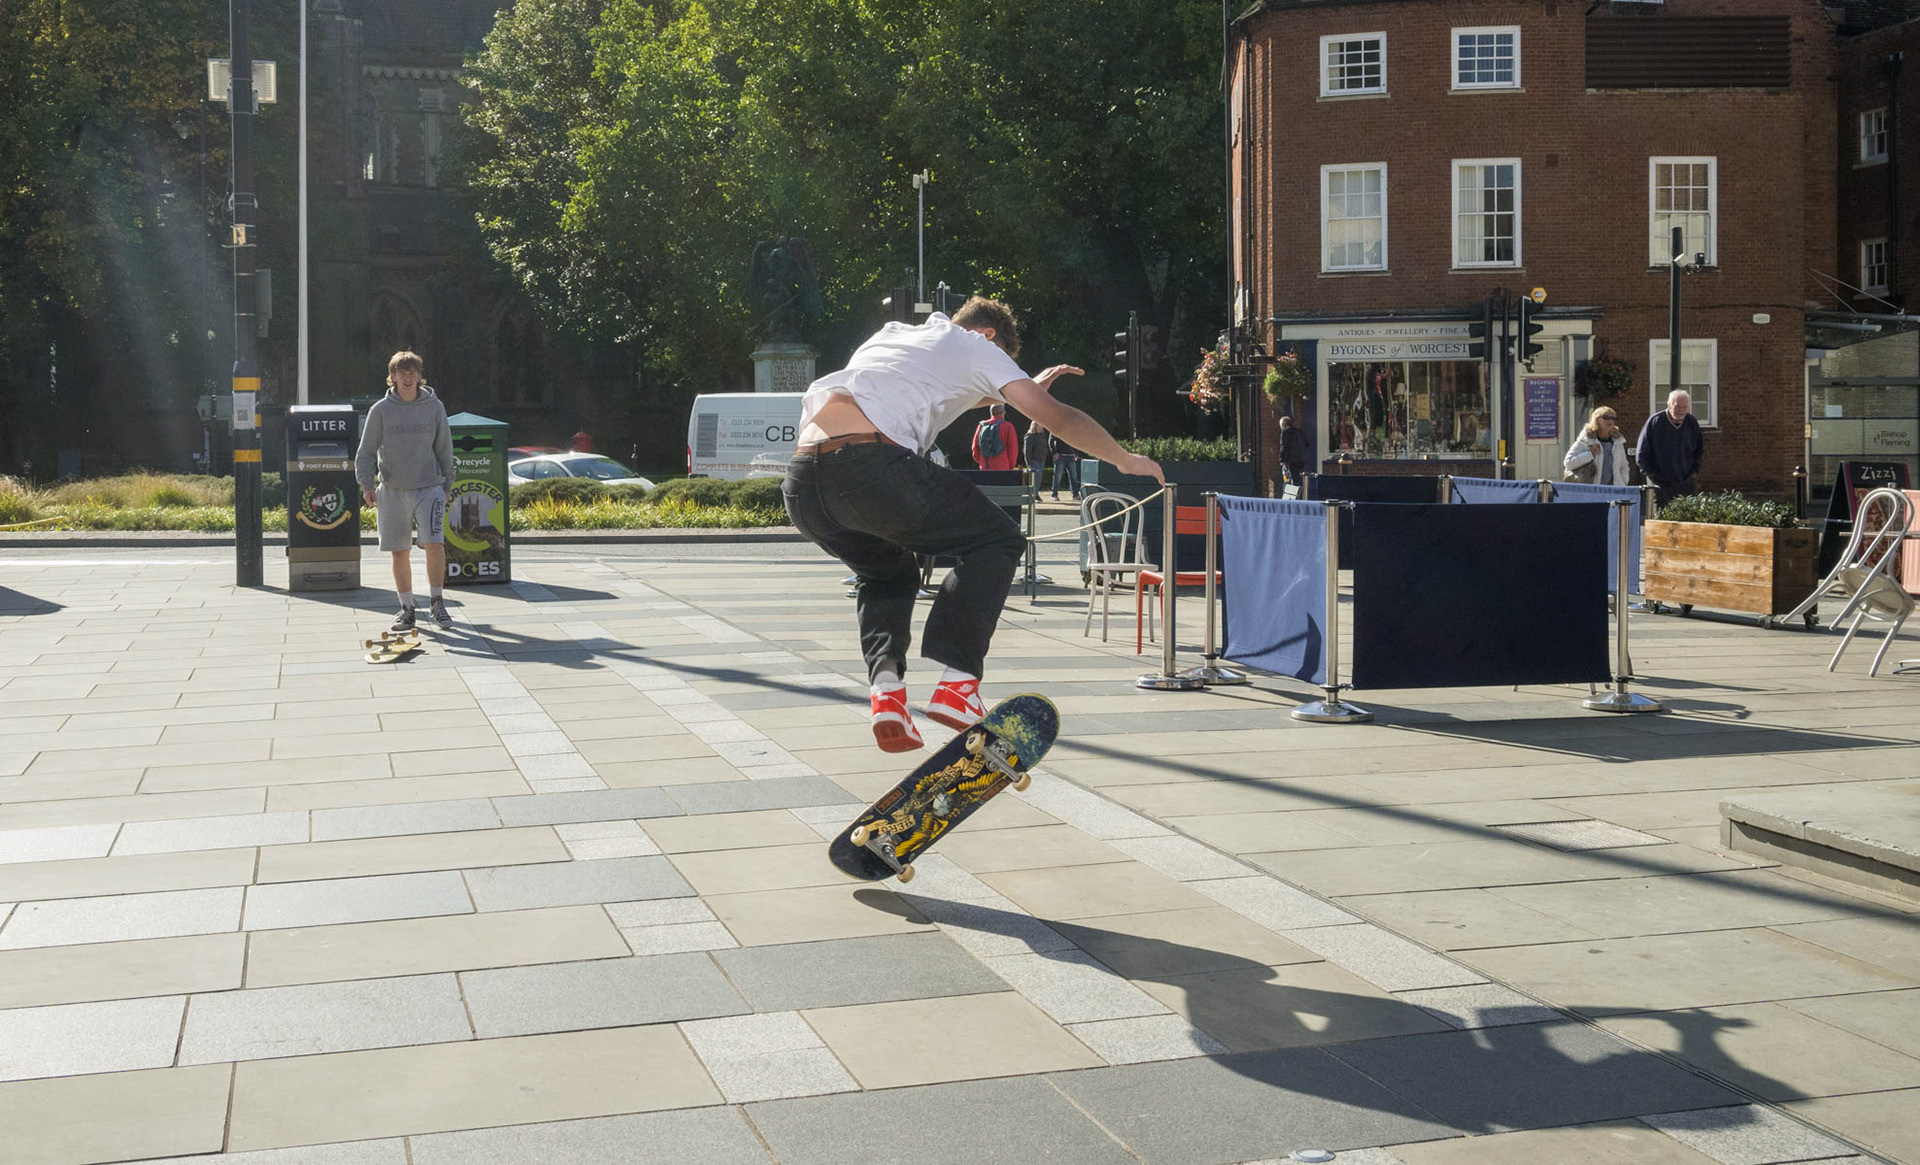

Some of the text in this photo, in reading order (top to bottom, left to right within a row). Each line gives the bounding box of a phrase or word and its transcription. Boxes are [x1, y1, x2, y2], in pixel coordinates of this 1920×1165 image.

[1384, 328, 1429, 336] JEWELLERY
[1440, 327, 1459, 335] FINE
[1331, 344, 1386, 355] BYGONES
[1390, 343, 1405, 357] of
[303, 420, 347, 431] LITTER
[1881, 430, 1907, 438] Bishop
[1881, 439, 1910, 447] Fleming
[462, 456, 491, 467] recycle
[458, 466, 491, 475] Worcester
[696, 463, 729, 471] COMPLETE
[1861, 466, 1897, 481] Zizzi
[448, 561, 500, 577] DOES
